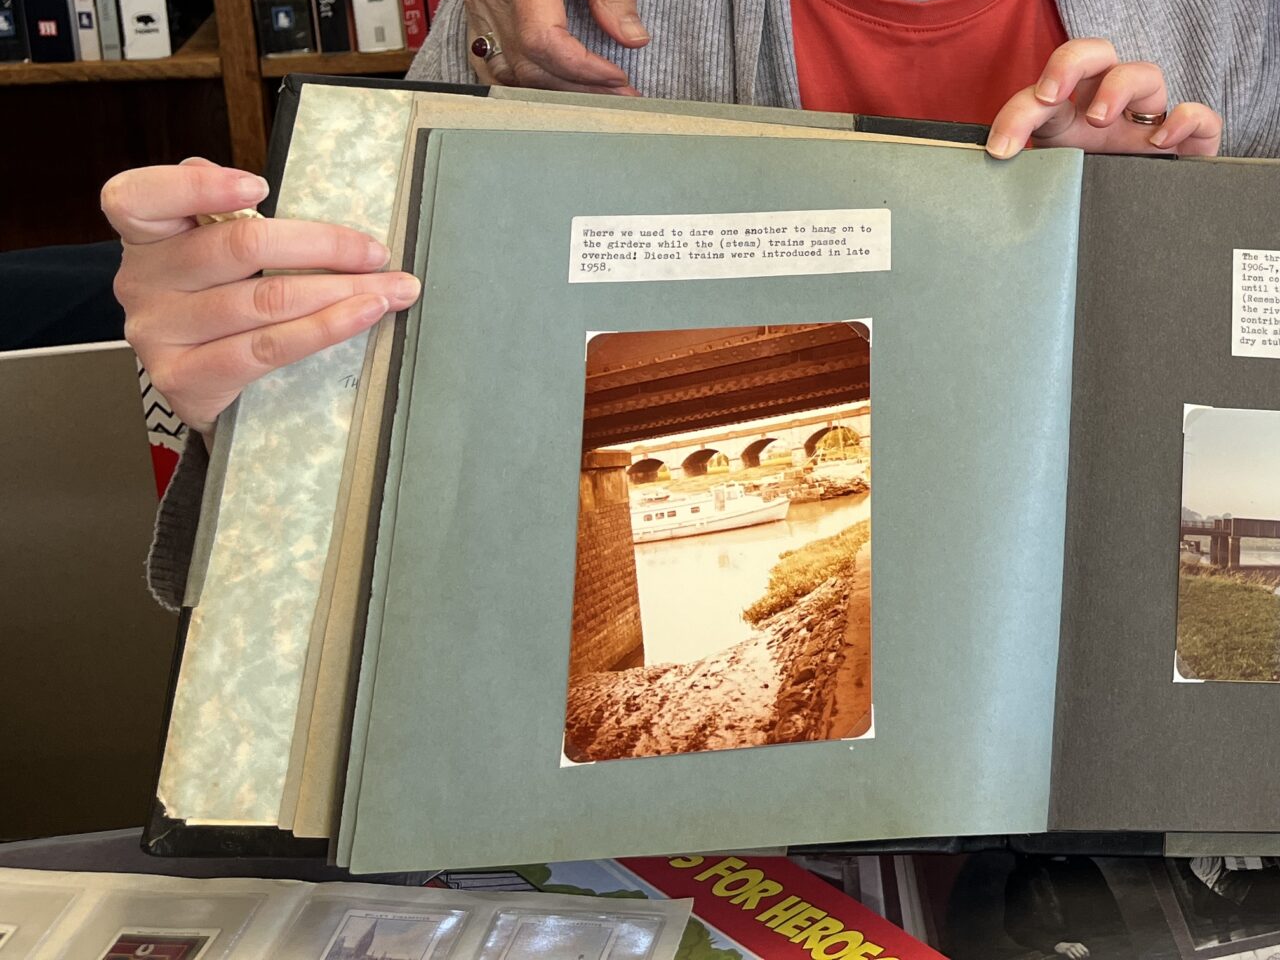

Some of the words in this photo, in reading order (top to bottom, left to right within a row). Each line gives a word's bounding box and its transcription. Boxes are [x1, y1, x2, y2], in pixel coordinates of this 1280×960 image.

[583, 229, 614, 237] Where
[640, 229, 664, 237] used
[690, 228, 714, 236] dare
[745, 226, 788, 235] another
[812, 225, 836, 234] hang
[607, 240, 651, 249] girders
[658, 239, 688, 247] while
[720, 238, 761, 249] (steam)
[769, 238, 804, 247] trains
[810, 238, 846, 247] passed
[582, 252, 637, 260] overhead!
[689, 251, 724, 259] trains
[762, 249, 822, 258] introduced
[829, 248, 840, 256] in
[846, 248, 870, 256] late
[694, 856, 783, 910] FOR
[756, 896, 899, 960] HEROE
